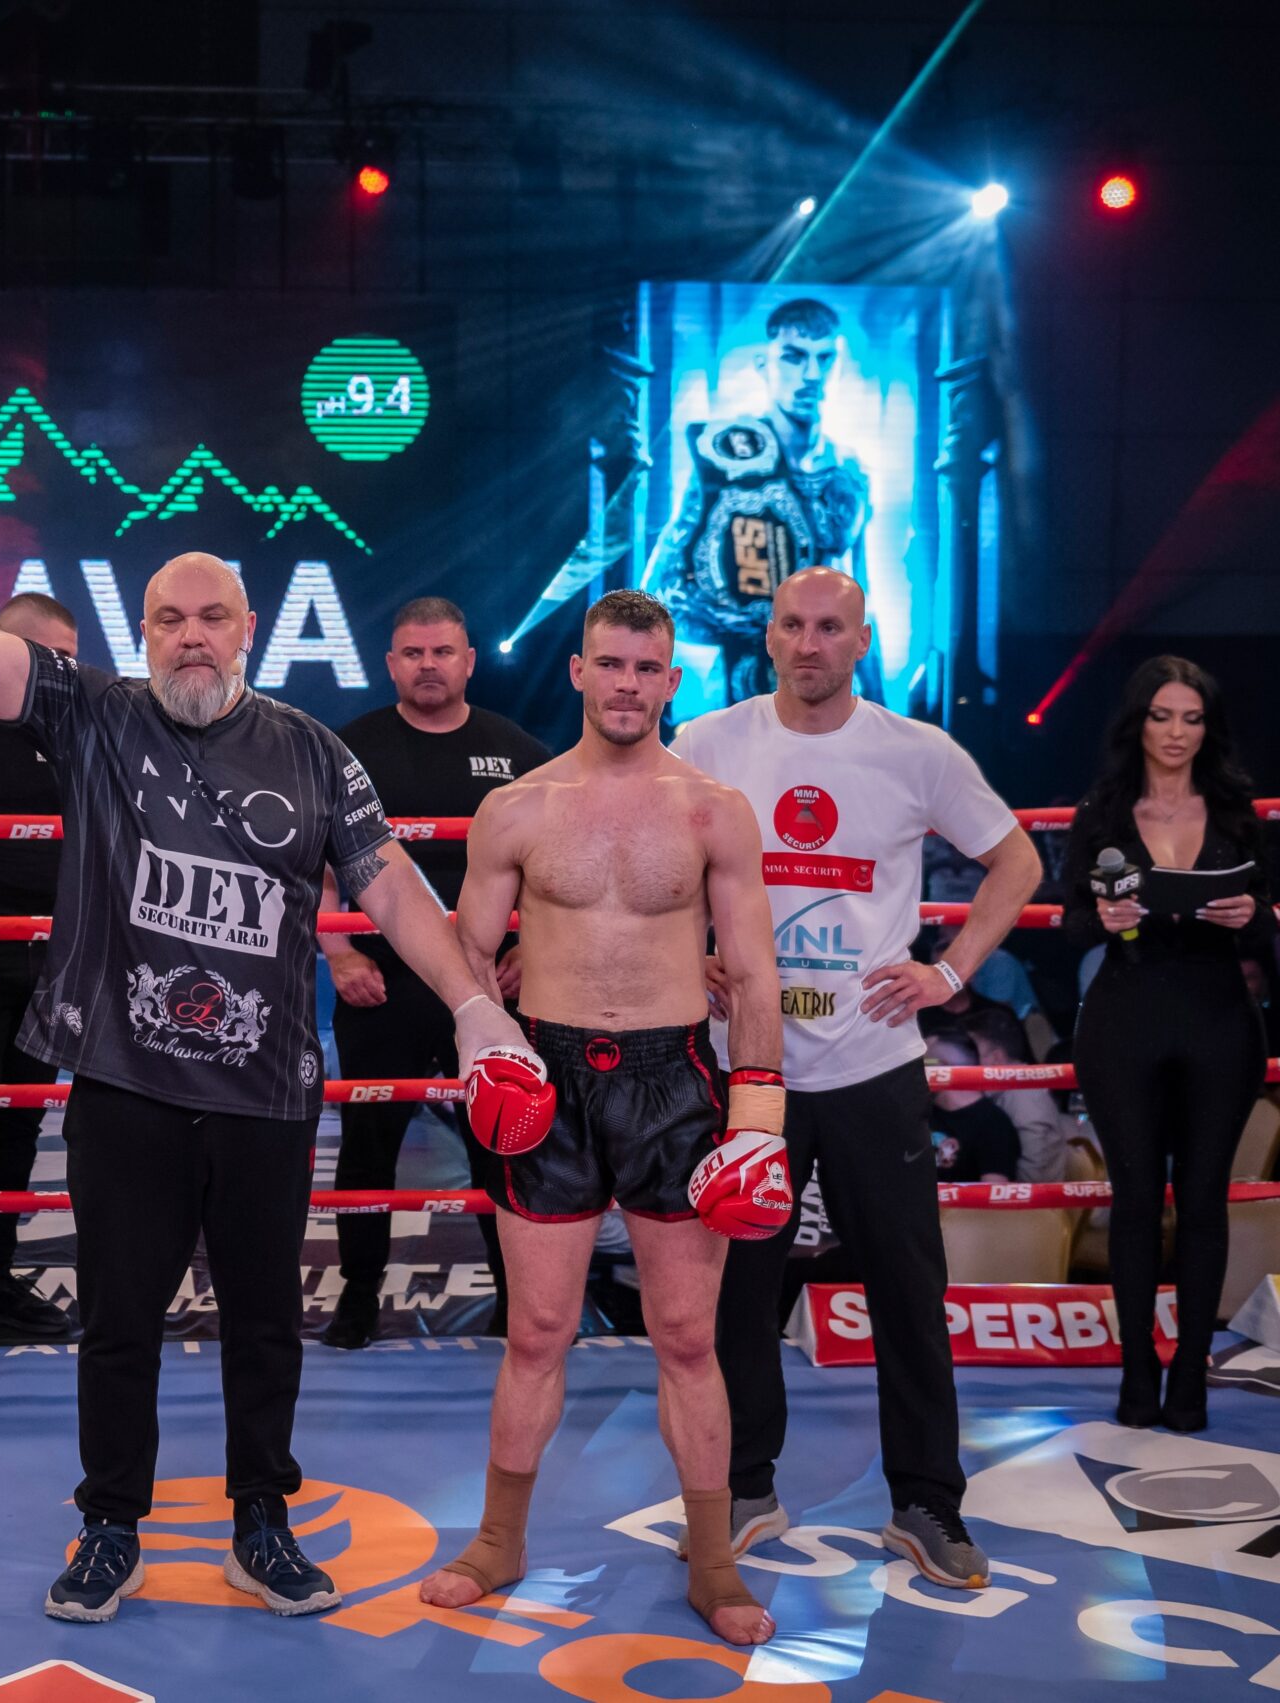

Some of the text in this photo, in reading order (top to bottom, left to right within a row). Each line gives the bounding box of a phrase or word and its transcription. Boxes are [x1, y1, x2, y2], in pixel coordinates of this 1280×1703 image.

[469, 757, 512, 774] DEY
[793, 788, 820, 799] MMA
[8, 824, 55, 839] DFS
[394, 823, 436, 840] DFS
[782, 832, 826, 850] SECURITY
[764, 865, 843, 877] MMA SECURITY
[140, 850, 276, 930] DEY
[1114, 871, 1140, 896] DFS
[137, 905, 269, 949] SECURITY ARAD
[779, 960, 853, 970] AUTO
[983, 1065, 1066, 1081] SUPERBET
[349, 1085, 395, 1102] DFS
[989, 1182, 1033, 1200] DFS
[422, 1199, 467, 1213] DFS
